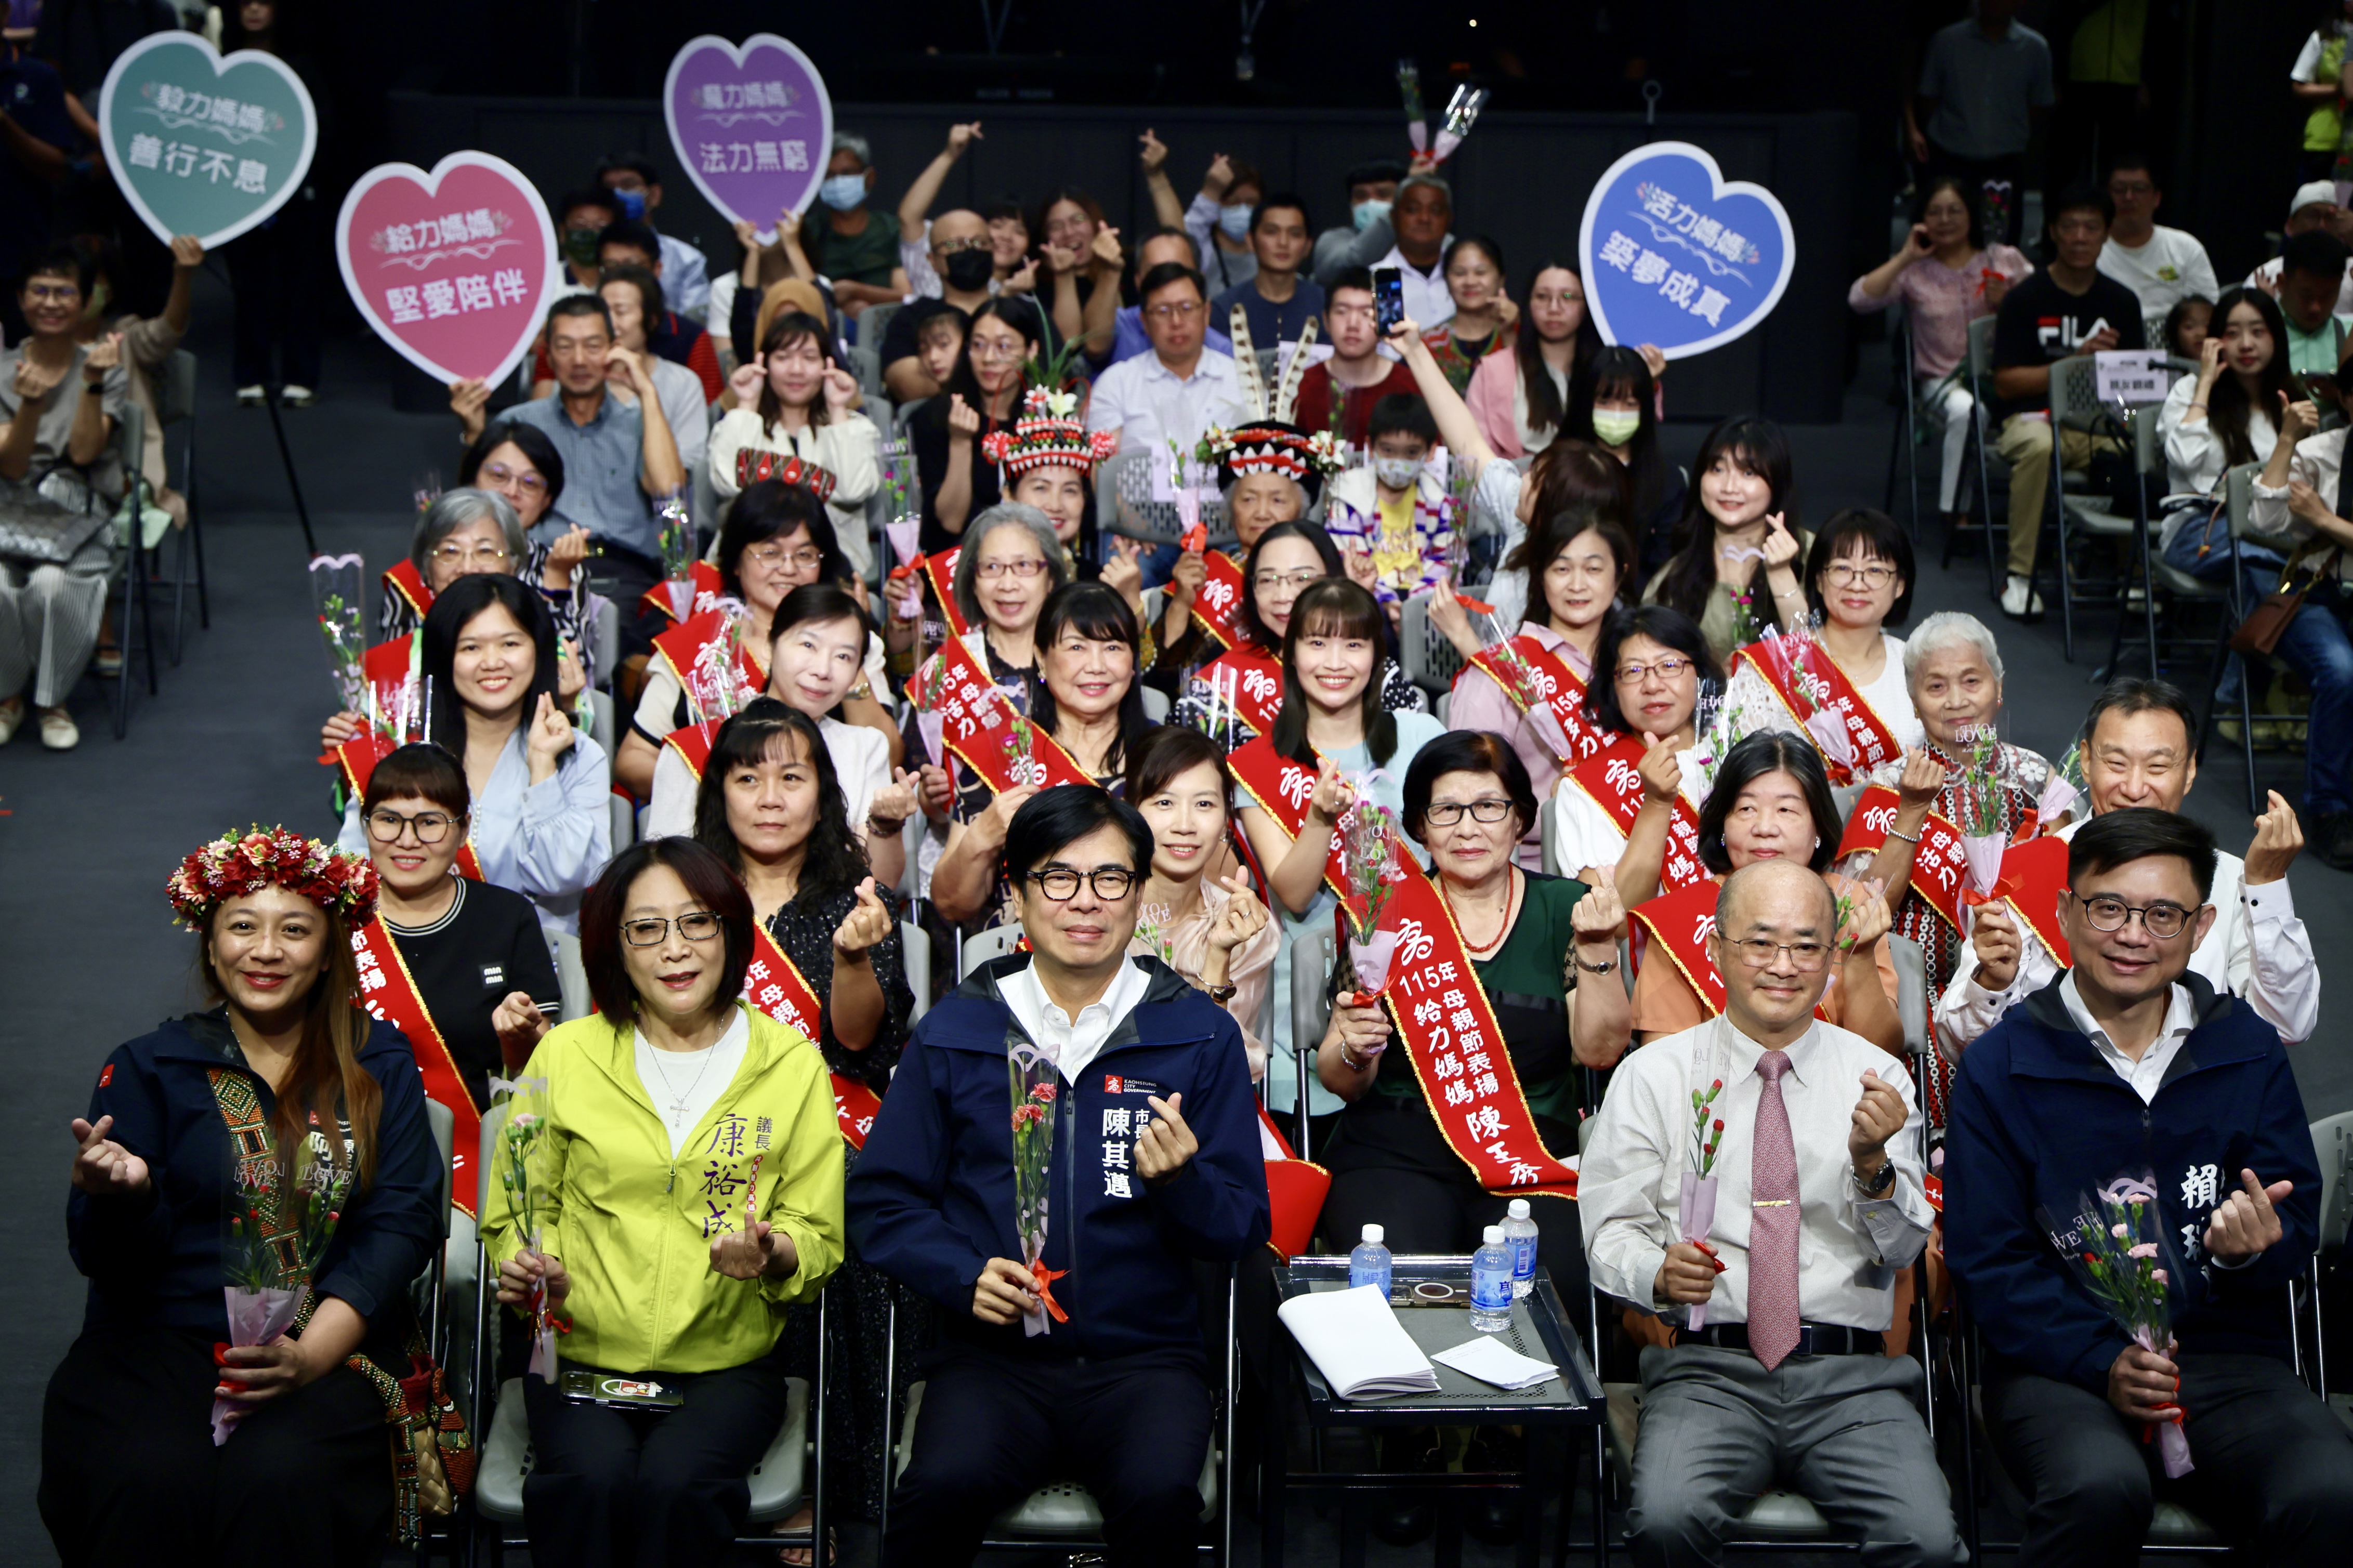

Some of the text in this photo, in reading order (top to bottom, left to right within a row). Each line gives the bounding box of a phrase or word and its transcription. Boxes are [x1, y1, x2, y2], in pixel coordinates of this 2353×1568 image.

[129, 132, 268, 194] 善行不息
[699, 140, 809, 174] 法力無窮
[385, 208, 495, 254] 給力媽媽
[385, 268, 528, 324] 堅愛陪伴
[1598, 230, 1731, 328] 築夢成真
[1916, 847, 1956, 892] 活力
[1414, 998, 1475, 1107] 給力媽媽
[1124, 1079, 1156, 1087] KAOHSIUNG
[755, 1116, 773, 1151] 議長
[1101, 1108, 1132, 1198] 陳其邁
